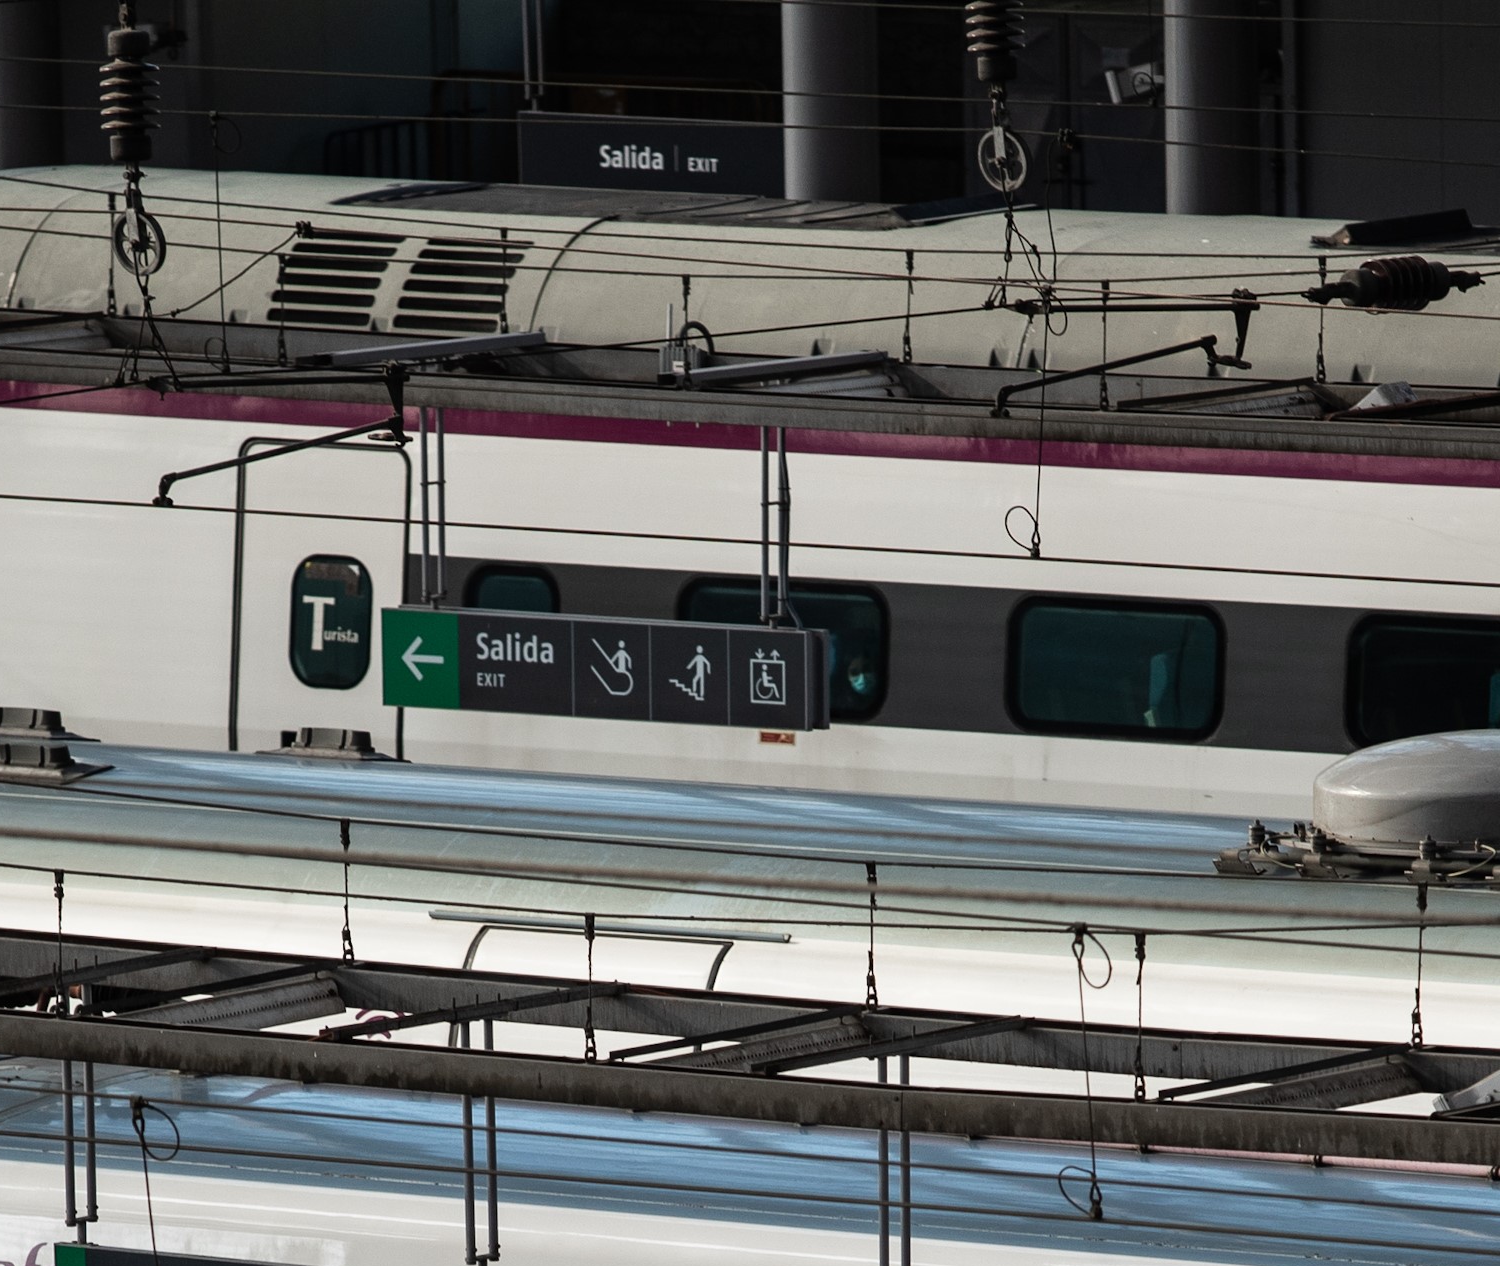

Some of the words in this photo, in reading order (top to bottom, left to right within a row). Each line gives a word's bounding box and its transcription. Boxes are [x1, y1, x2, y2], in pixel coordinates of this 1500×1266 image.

[599, 144, 664, 170] Salida
[687, 157, 719, 172] EXIT
[476, 632, 554, 664] Salida
[476, 672, 506, 688] EXIT
